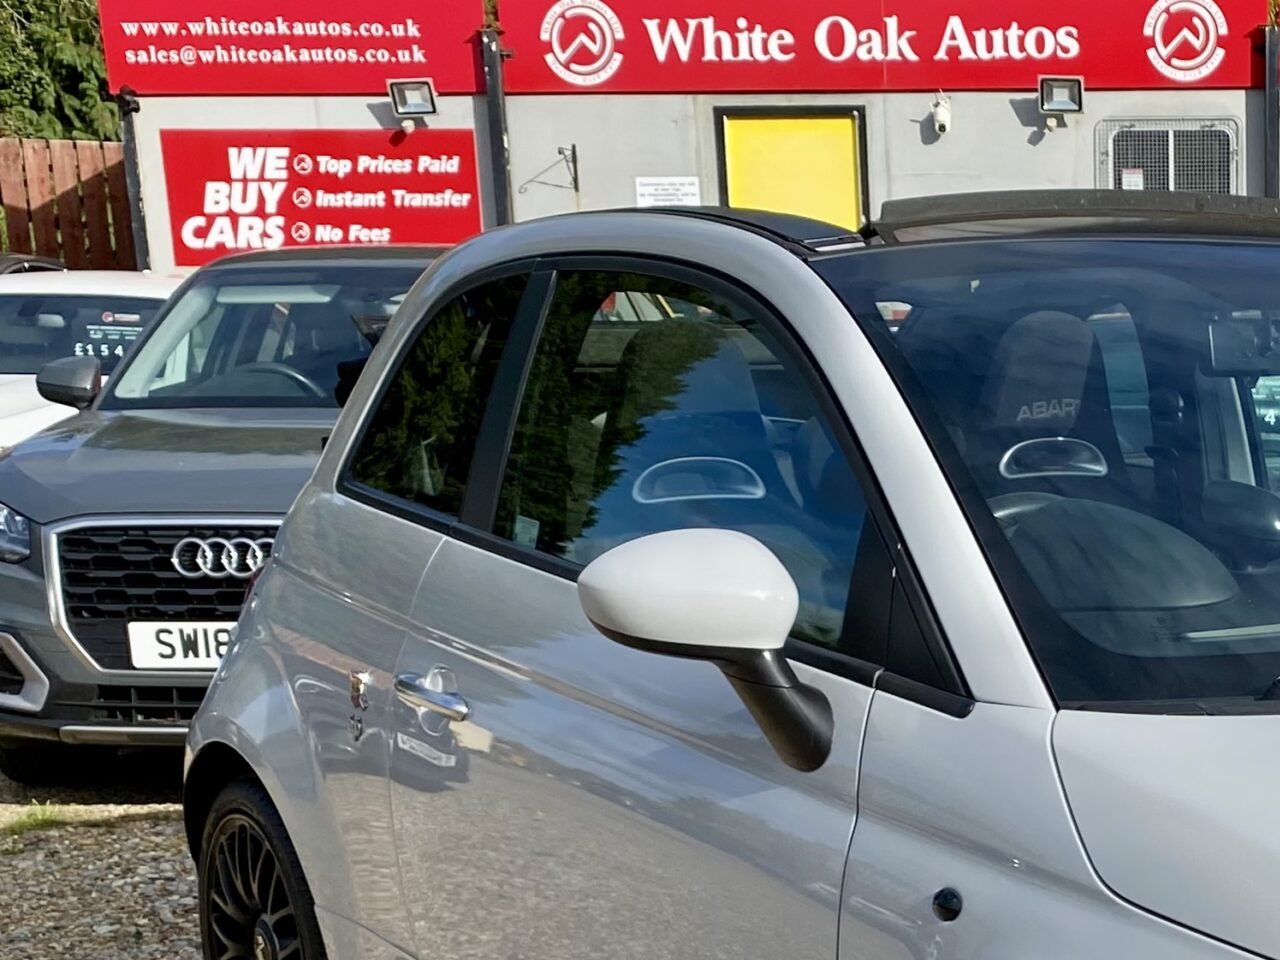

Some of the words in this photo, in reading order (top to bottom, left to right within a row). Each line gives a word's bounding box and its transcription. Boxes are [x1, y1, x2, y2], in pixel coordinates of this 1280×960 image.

[122, 17, 421, 38] www.whiteoakautos.co.uk
[644, 17, 796, 63] White
[815, 16, 920, 62] Oak
[934, 17, 1081, 61] Autos
[125, 44, 427, 67] sales@whiteoakautos.co.uk
[228, 147, 290, 181] WE
[316, 157, 352, 179] Top
[357, 156, 412, 175] Prices
[417, 156, 460, 174] Paid
[203, 182, 288, 215] BUY
[316, 190, 387, 209] Instant
[392, 190, 472, 209] Transfer
[182, 215, 285, 251] CARS
[315, 225, 343, 243] No
[346, 225, 391, 243] Fees
[74, 342, 124, 357] £154
[155, 628, 231, 659] SW18
